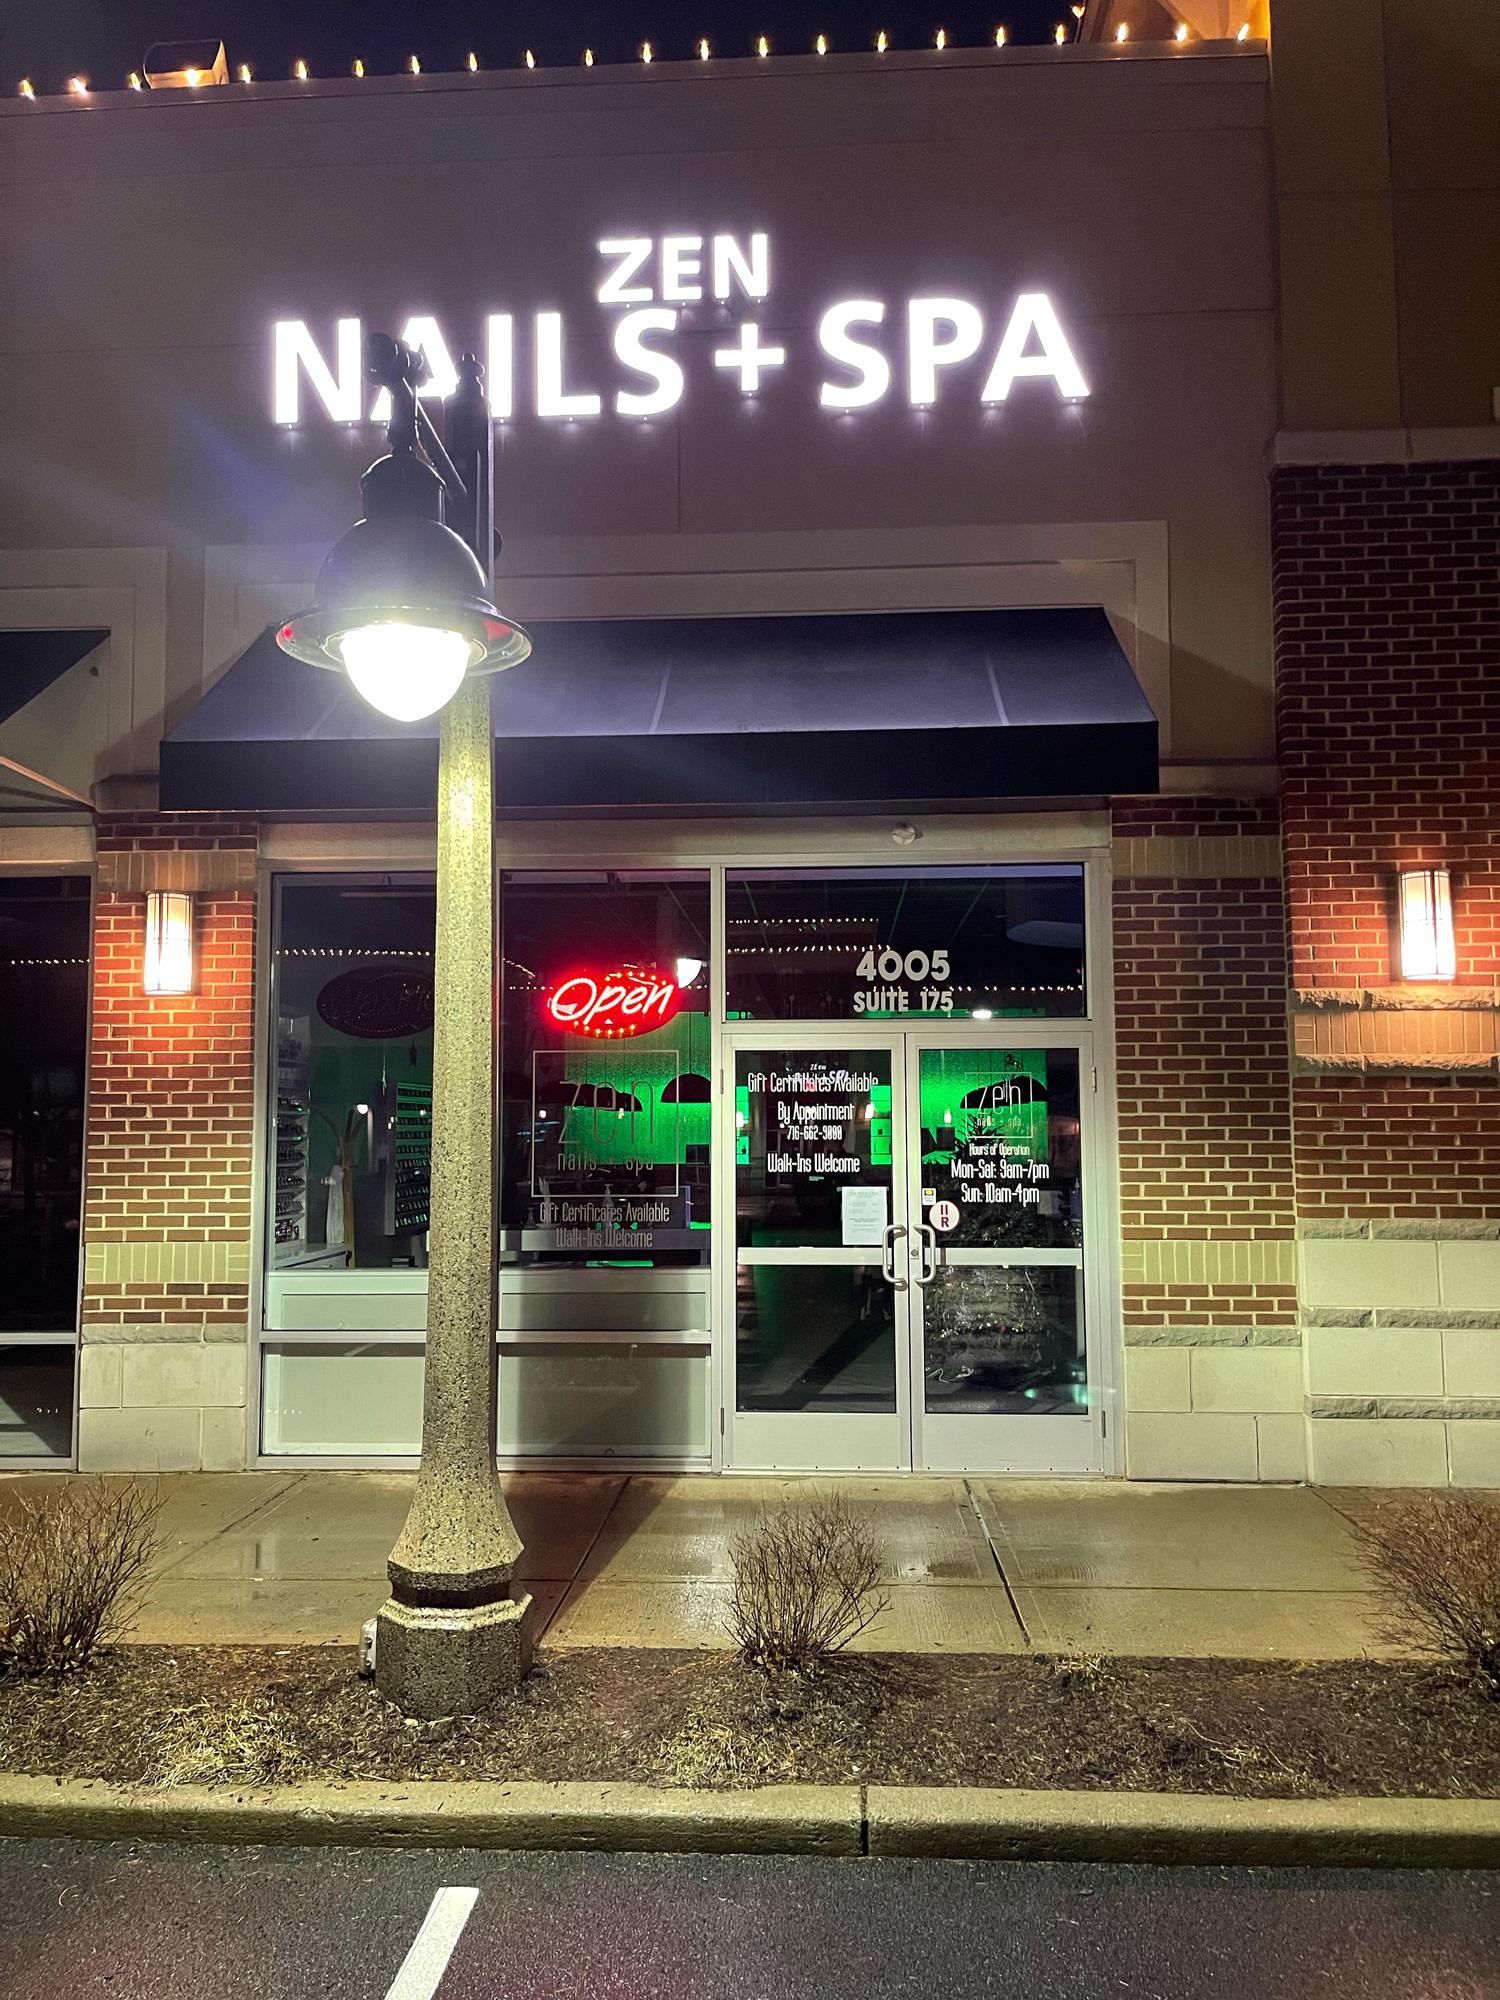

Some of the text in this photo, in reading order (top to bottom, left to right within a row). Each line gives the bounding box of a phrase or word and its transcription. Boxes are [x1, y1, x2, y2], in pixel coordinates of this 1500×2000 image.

[599, 232, 768, 304] ZEN
[274, 293, 1091, 425] NAILS + SPA
[855, 949, 950, 982] 4005
[550, 977, 675, 1026] Open
[853, 991, 954, 1014] SUITE 175
[747, 1072, 767, 1093] Gift
[770, 1072, 831, 1093] Certificates
[834, 1072, 879, 1093] Available
[559, 1080, 654, 1144] zen
[777, 1101, 855, 1125] By Appointment
[976, 1114, 997, 1128] nas
[787, 1125, 843, 1141] 716-662-9000
[969, 1142, 1031, 1159] Hours of Operation
[557, 1152, 597, 1172] nails
[767, 1153, 861, 1173] Walk-Ins Welcome
[950, 1159, 1050, 1184] Mon-Sat: 9am-7pm
[961, 1182, 1041, 1208] Sun: 10am-4pm
[562, 1202, 623, 1222] Certificates
[626, 1202, 670, 1222] Available
[941, 1216, 950, 1228] R
[556, 1227, 654, 1248] Walk-Ins Welcome
